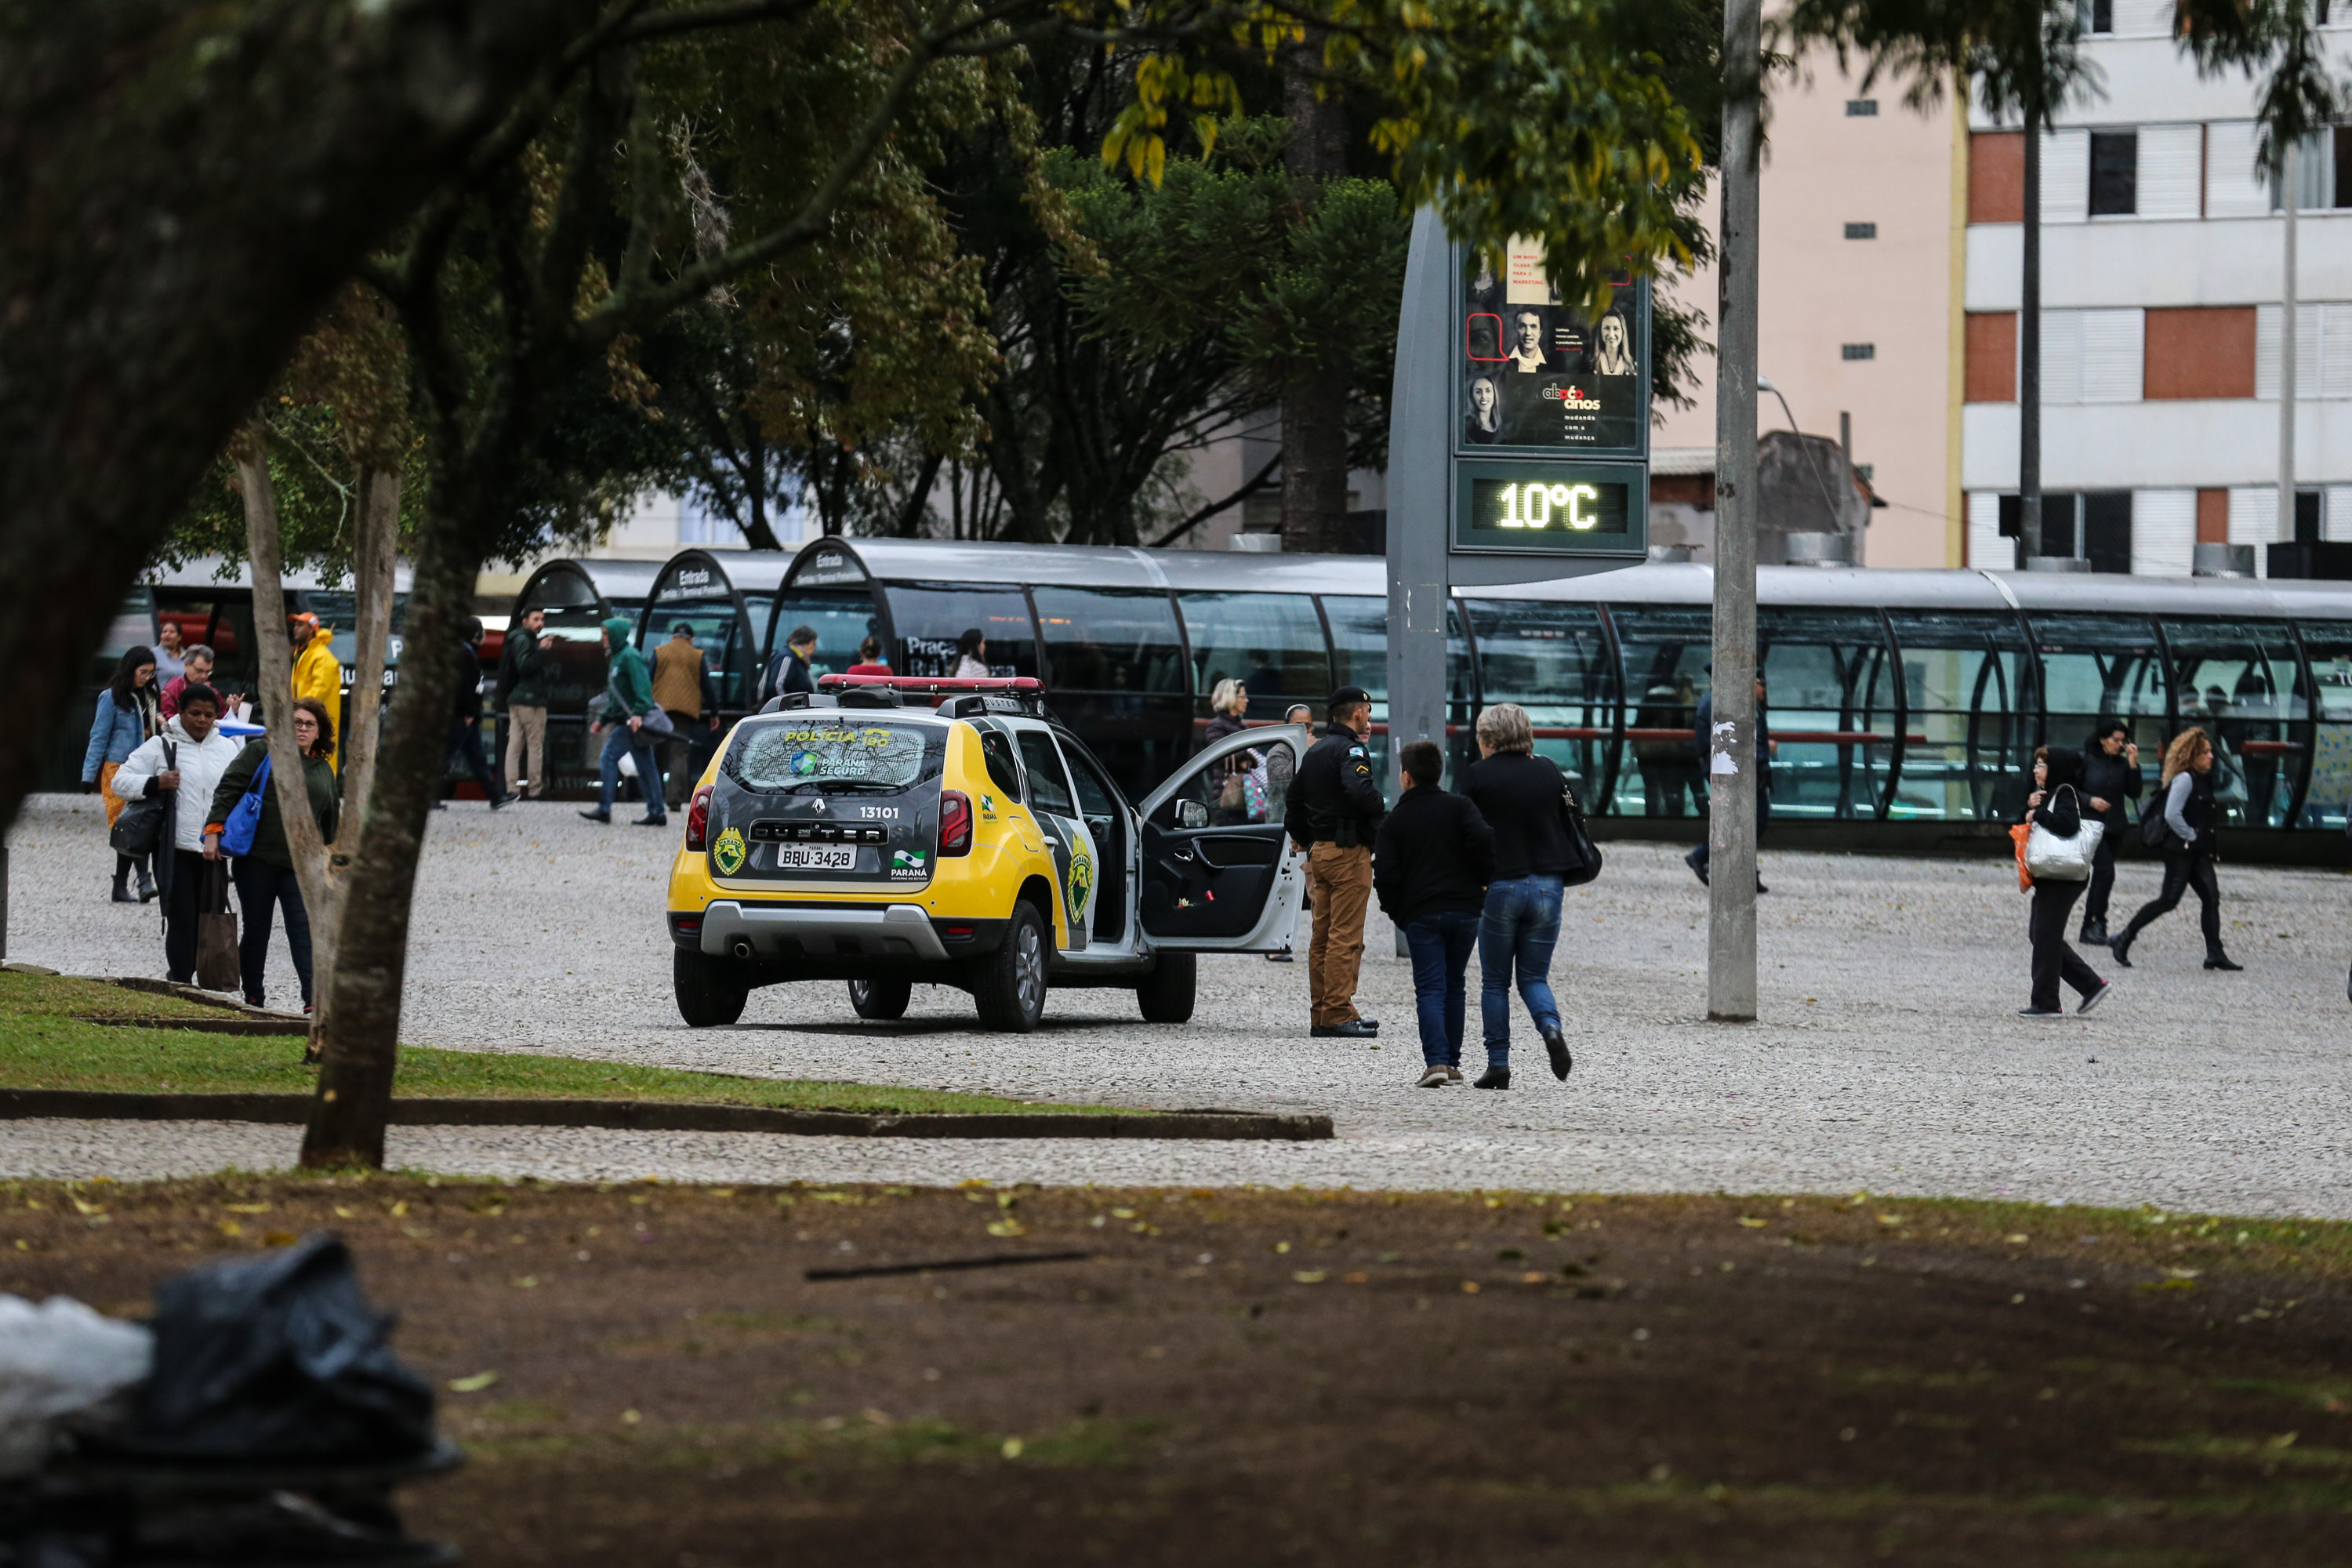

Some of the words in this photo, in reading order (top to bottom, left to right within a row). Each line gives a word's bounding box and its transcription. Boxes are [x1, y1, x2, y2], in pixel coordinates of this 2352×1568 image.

[1564, 399, 1601, 410] anos
[816, 553, 843, 568] Entrada
[679, 568, 710, 586] Entrada
[906, 636, 957, 659] Praça
[985, 699, 1017, 708] DUSTER
[785, 728, 855, 742] POLÍCIA
[862, 737, 888, 747] 190
[819, 767, 866, 775] SEGURO
[860, 806, 899, 819] 13101
[755, 828, 880, 840] DUSTER
[891, 867, 927, 877] PARANÁ
